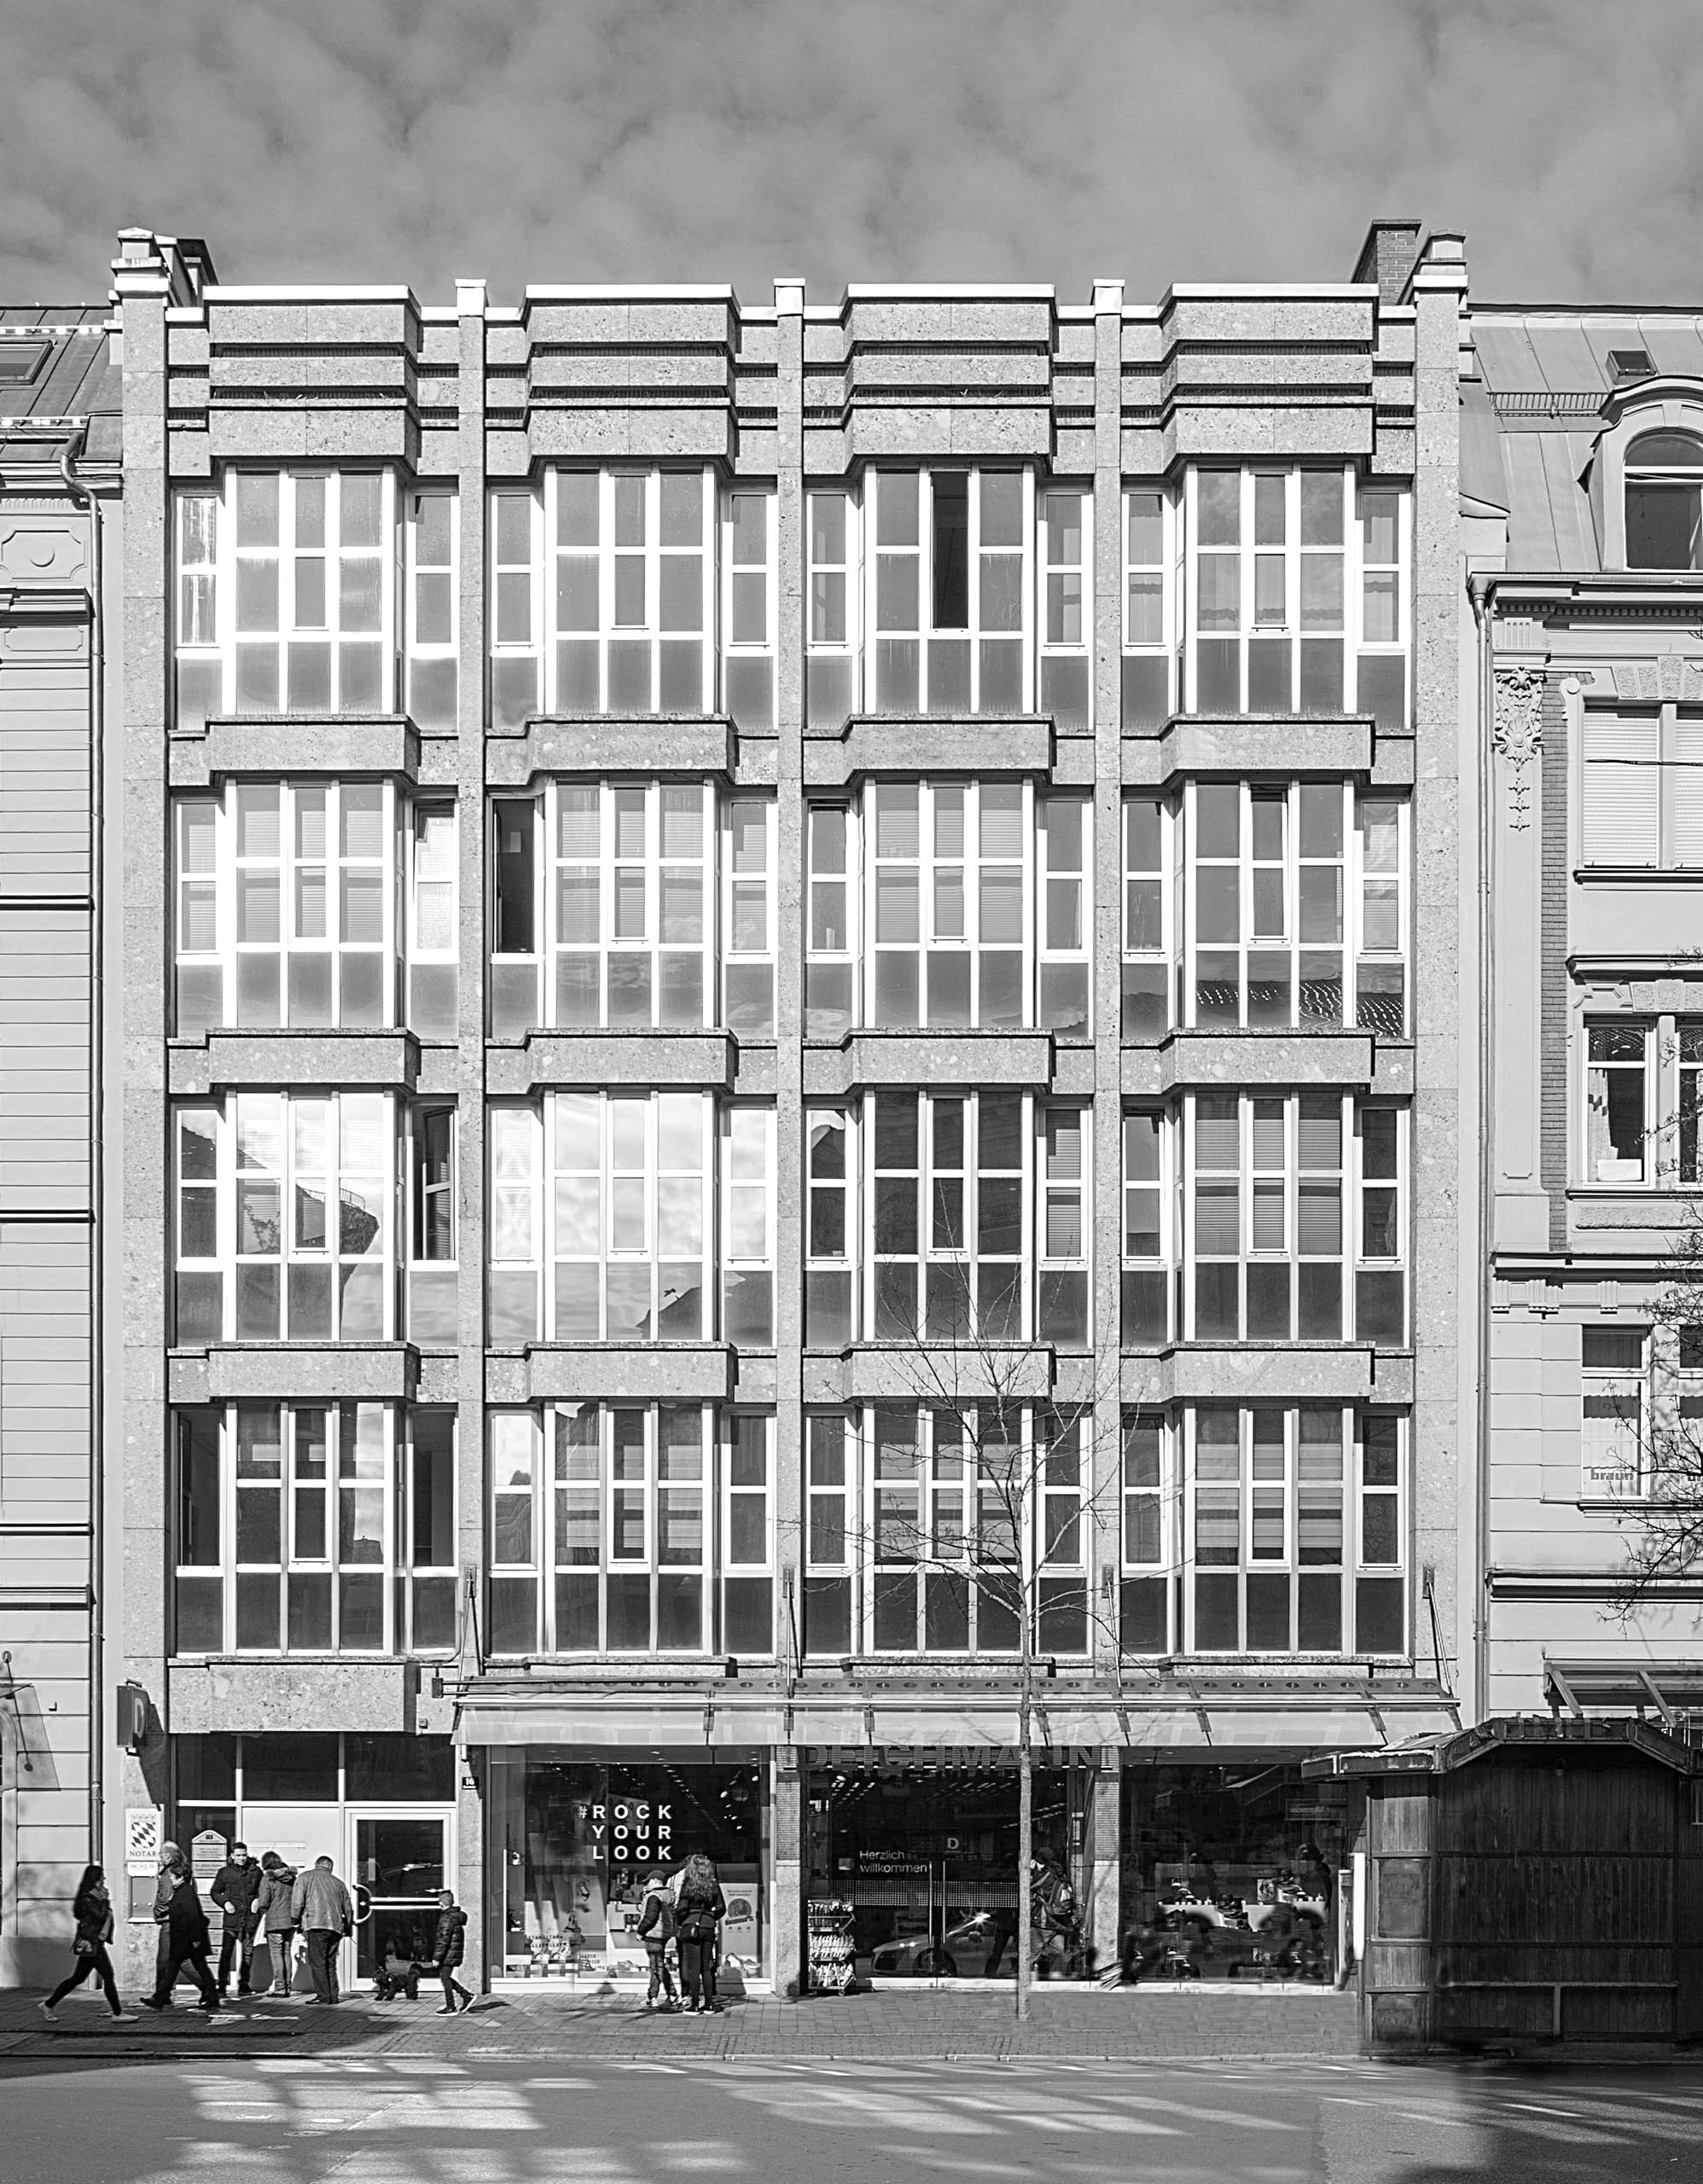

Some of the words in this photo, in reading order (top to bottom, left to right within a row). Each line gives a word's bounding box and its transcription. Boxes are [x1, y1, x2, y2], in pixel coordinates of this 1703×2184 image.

[1590, 1468, 1634, 1480] braun
[134, 1697, 144, 1739] D
[465, 1777, 474, 1786] 16
[580, 1804, 671, 1819] #ROCK
[591, 1825, 671, 1839] YOUR
[947, 1838, 959, 1850] D
[593, 1845, 671, 1860] LOOK
[859, 1850, 905, 1860] Herzlich
[859, 1863, 927, 1873] willkommen
